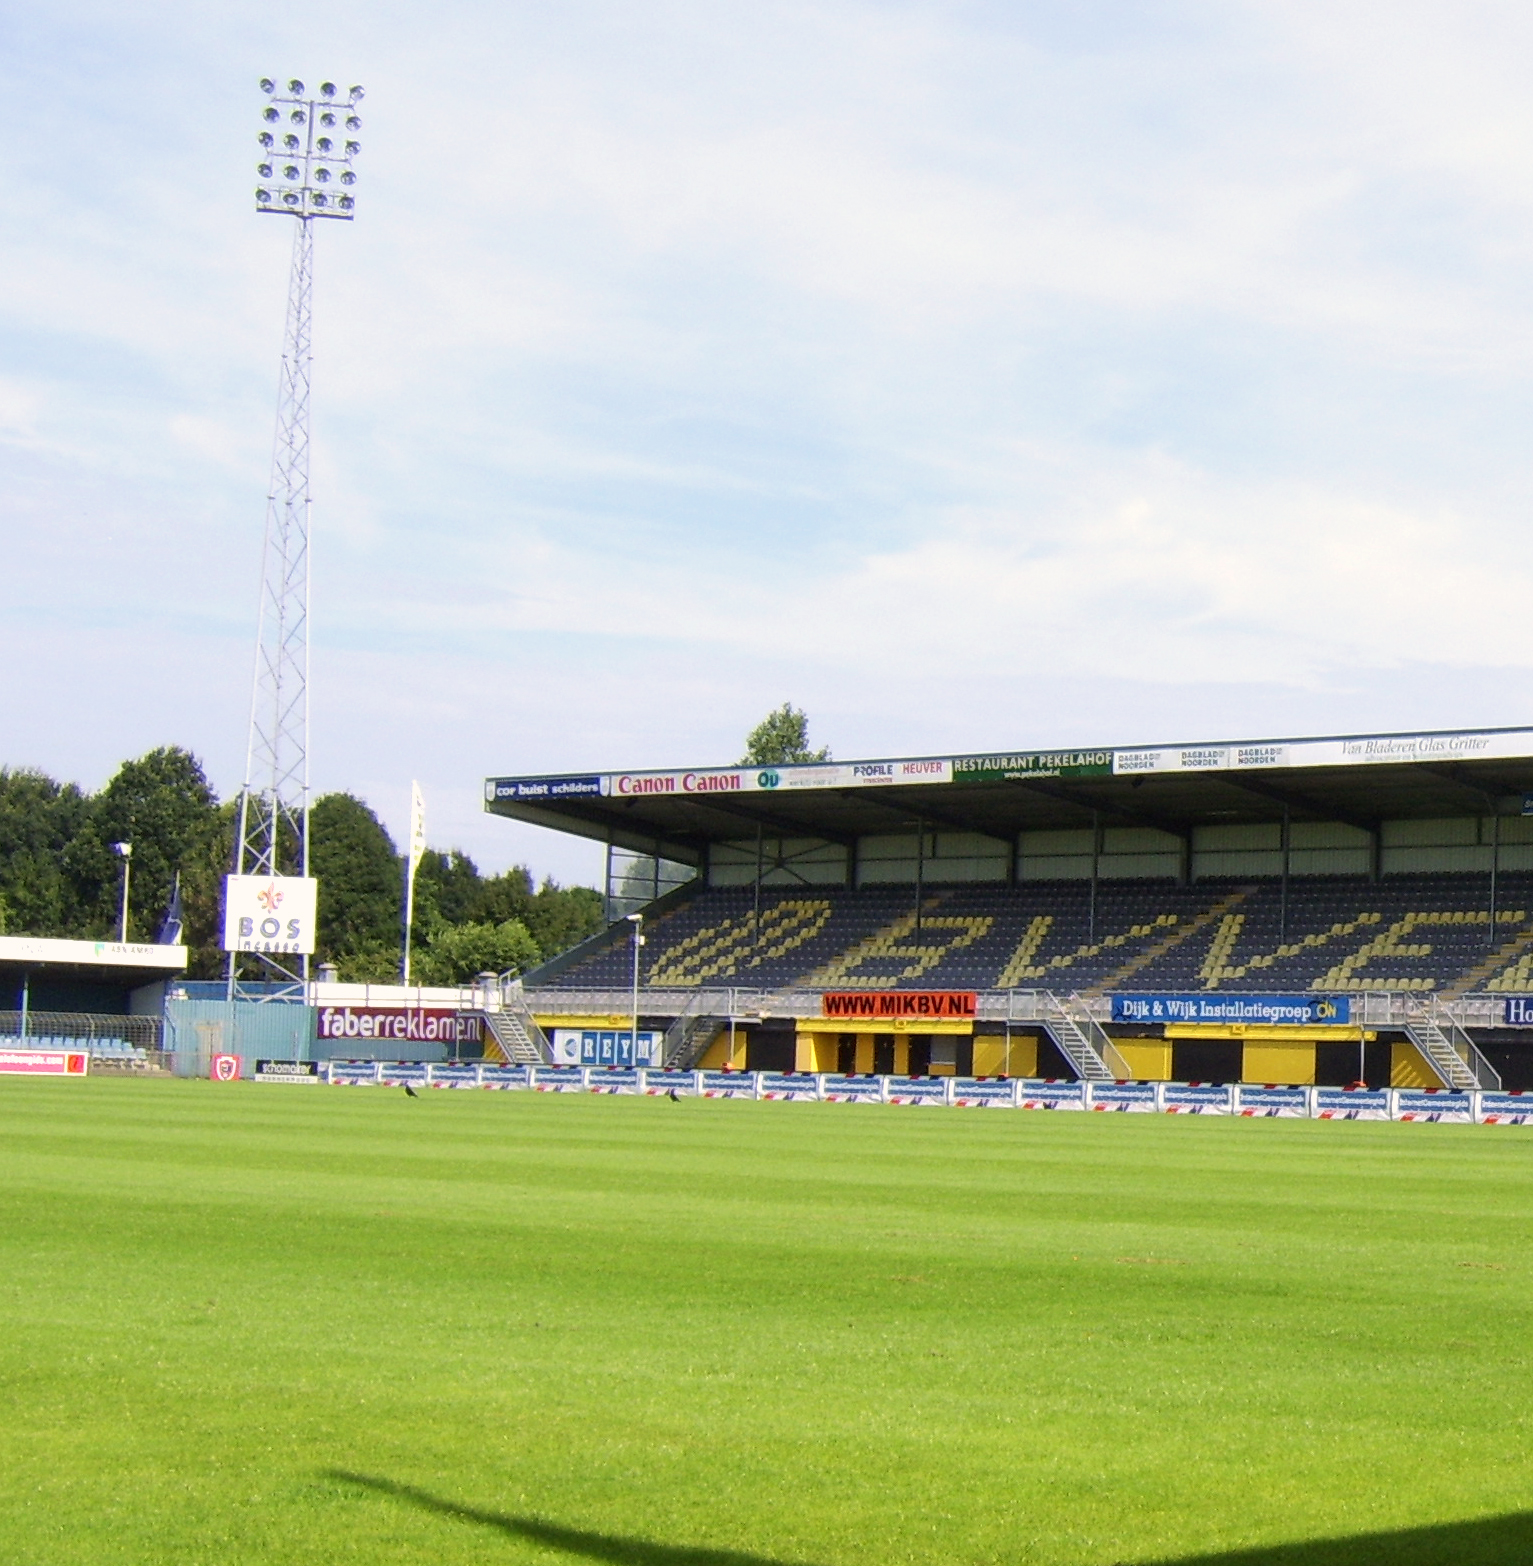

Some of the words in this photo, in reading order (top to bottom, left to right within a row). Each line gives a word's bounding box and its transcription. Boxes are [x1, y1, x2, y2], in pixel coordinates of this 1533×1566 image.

[1365, 740, 1416, 754] Bladeren
[1418, 738, 1445, 752] Glas
[902, 761, 943, 775] HEUVER
[954, 755, 1036, 773] RESTAURANT
[1039, 752, 1112, 768] PEKELAHOF
[618, 775, 676, 795] Canon
[682, 773, 742, 794] Canon
[238, 916, 301, 940] BOS
[1122, 999, 1149, 1020] Dijk
[1152, 1000, 1163, 1017] &
[1166, 1000, 1198, 1020] Wijk
[1200, 1000, 1312, 1023] Installatiegroep
[321, 1007, 481, 1041] faberreklame.nl
[583, 1038, 650, 1059] REYM
